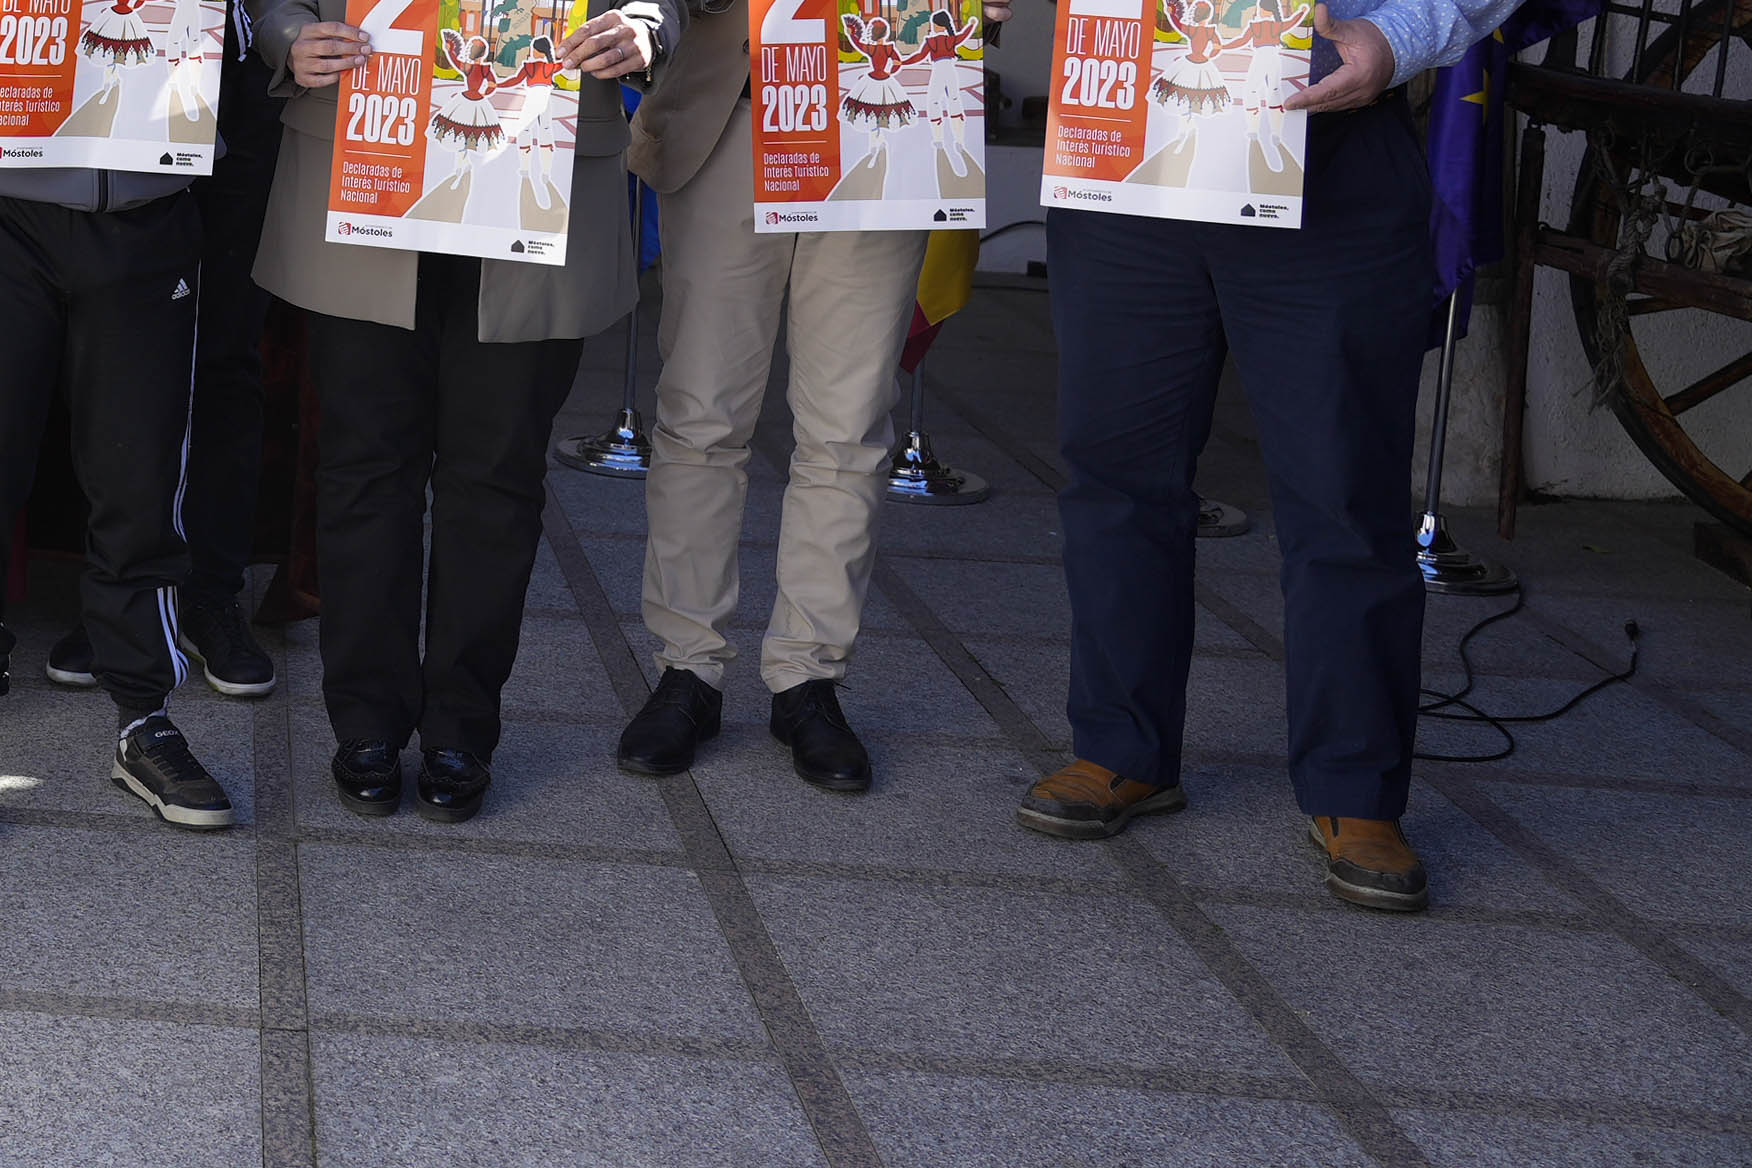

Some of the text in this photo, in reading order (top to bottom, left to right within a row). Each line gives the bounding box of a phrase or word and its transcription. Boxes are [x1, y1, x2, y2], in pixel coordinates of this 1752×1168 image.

[1066, 17, 1142, 59] DE MAYO
[761, 45, 827, 83] DE MAYO
[351, 54, 422, 96] DE MAYO
[1061, 56, 1137, 110] 2023
[43, 86, 54, 99] de
[26, 100, 61, 113] Turístico
[761, 84, 828, 133] 2023
[346, 92, 418, 146] 2023
[1058, 125, 1122, 143] Declaradas de
[3, 148, 44, 158] Móstoles
[1056, 139, 1131, 158] Interés Turístico
[763, 152, 820, 165] Declaradas de
[1055, 153, 1096, 168] Nacional
[343, 161, 403, 179] Declaradas de
[764, 165, 830, 178] Interés Turístico
[341, 175, 410, 193] Interés Turístico
[764, 180, 800, 192] Nacional
[340, 189, 378, 204] Nacional
[1067, 190, 1113, 202] Móstoles
[778, 213, 819, 222] Móstoles
[351, 226, 393, 238] Móstoles
